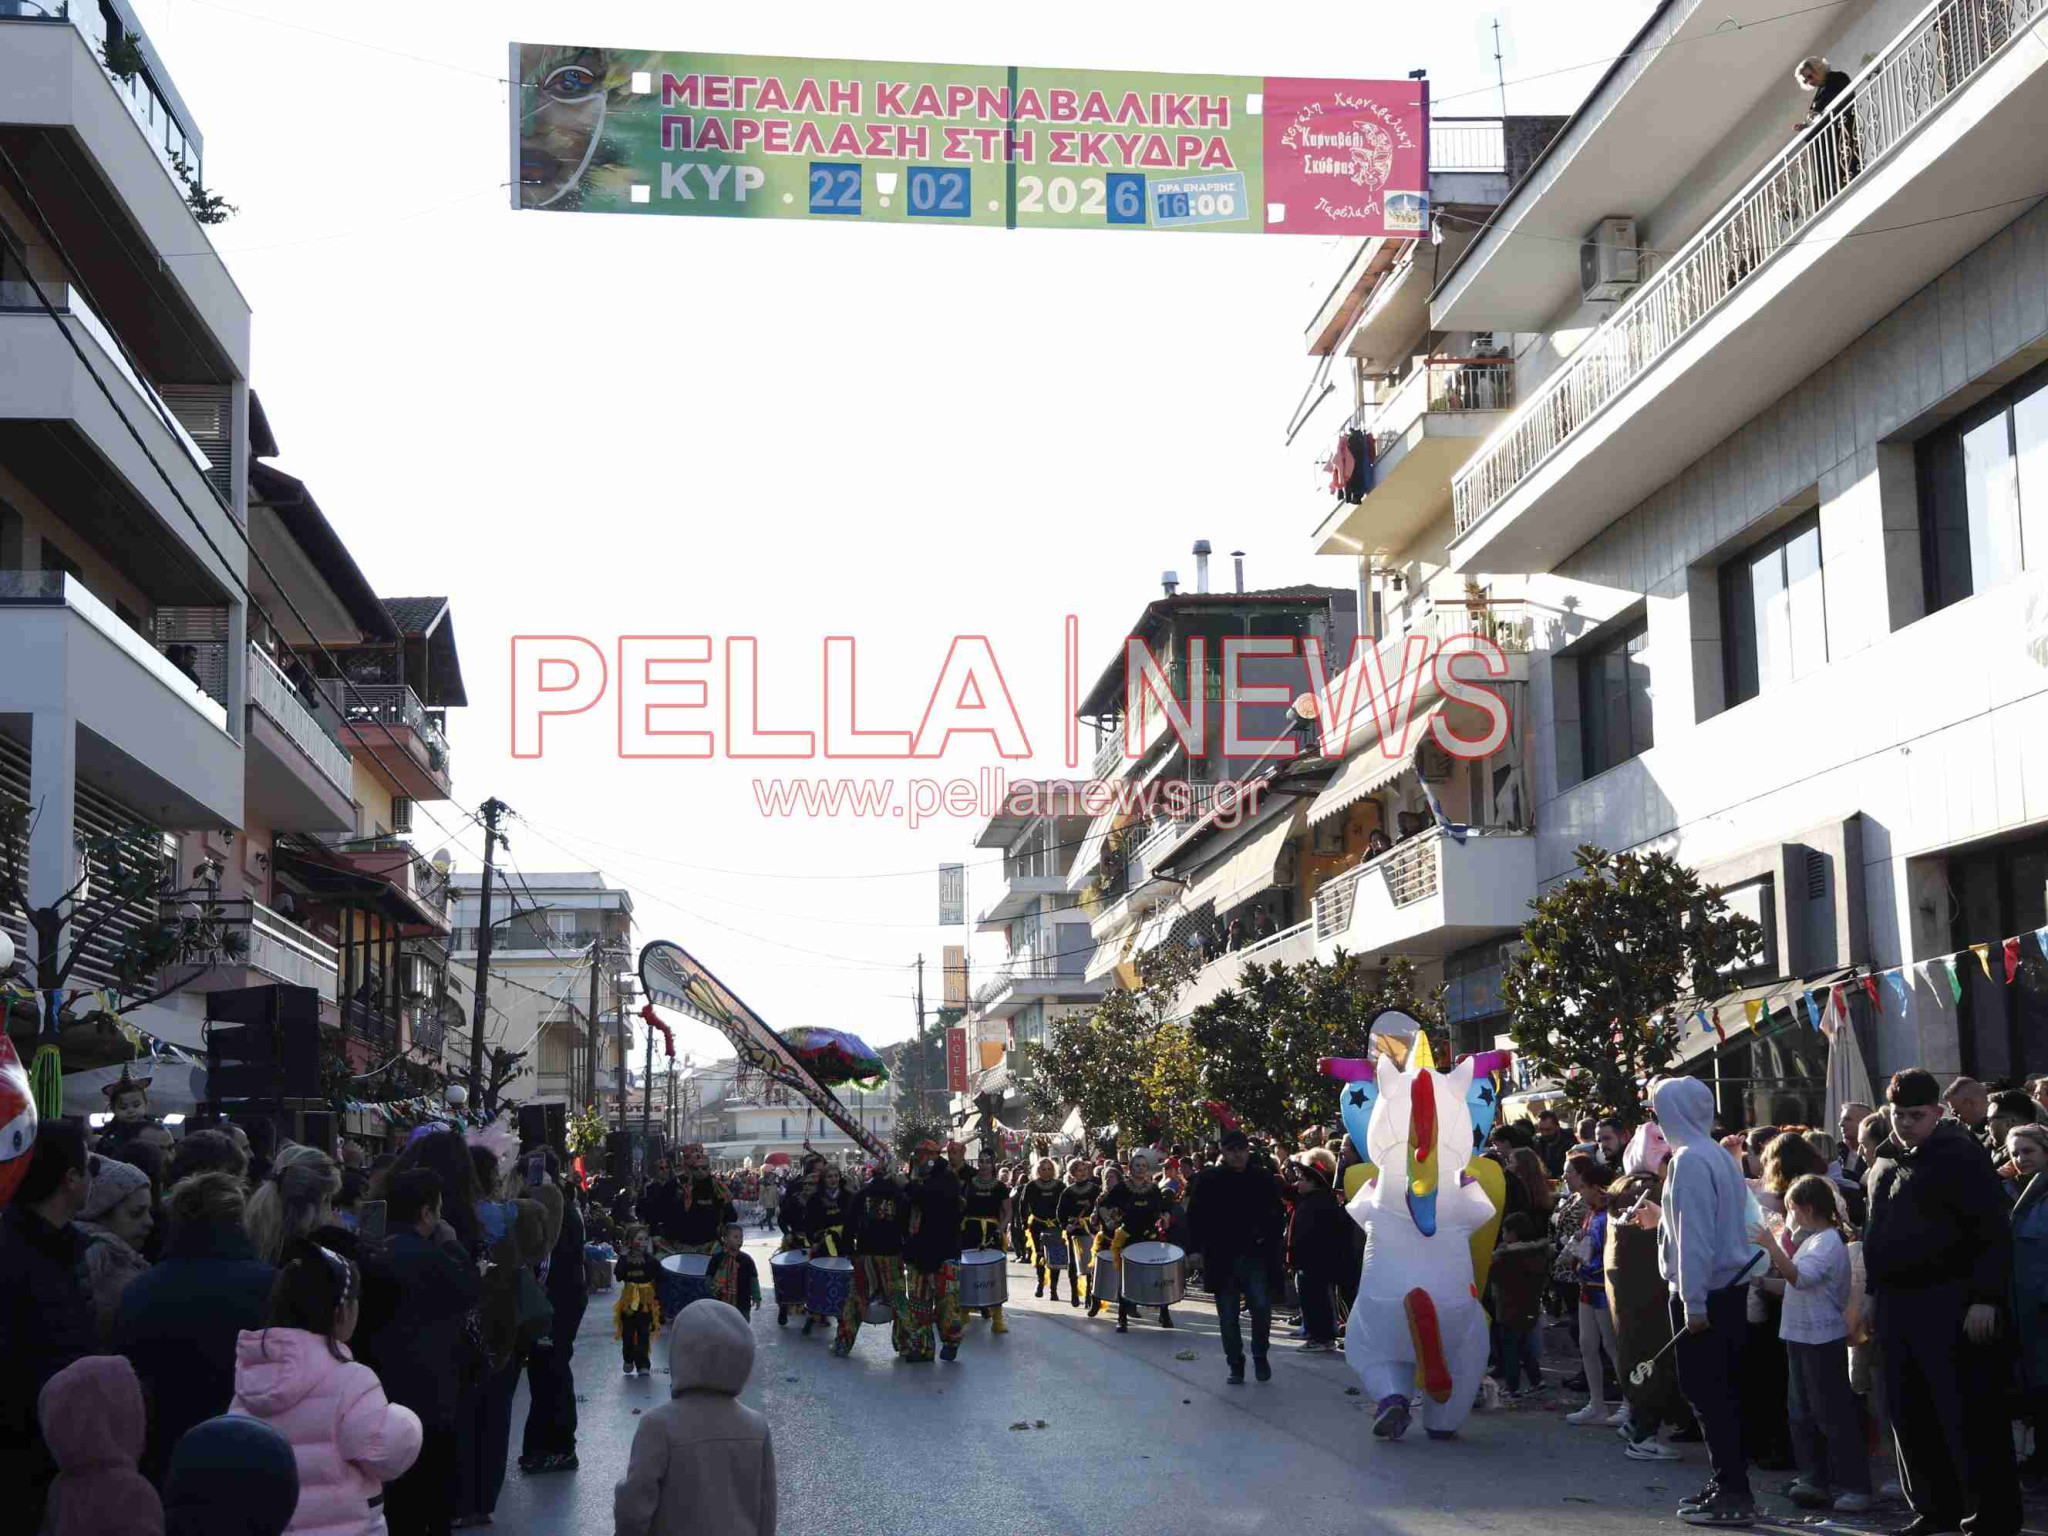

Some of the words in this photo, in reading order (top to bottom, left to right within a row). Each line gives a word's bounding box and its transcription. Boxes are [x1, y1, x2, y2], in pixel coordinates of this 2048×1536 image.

[661, 73, 863, 116] ΜΕΓΑΛΗ
[876, 81, 1231, 130] ΚΑΡΝΑΒΑΛΙΚΗ
[661, 114, 930, 161] ΠΑΡΕΛΑΣΗ
[943, 126, 1036, 165] ΣΤΗ
[1048, 130, 1238, 171] ΣΚΥΔΡΑ
[1017, 175, 1140, 217] 2026
[1158, 184, 1180, 193] ΩΡΑ
[1183, 182, 1236, 193] ΕΝΑΡΞΗΣ
[1158, 194, 1235, 217] 16:00
